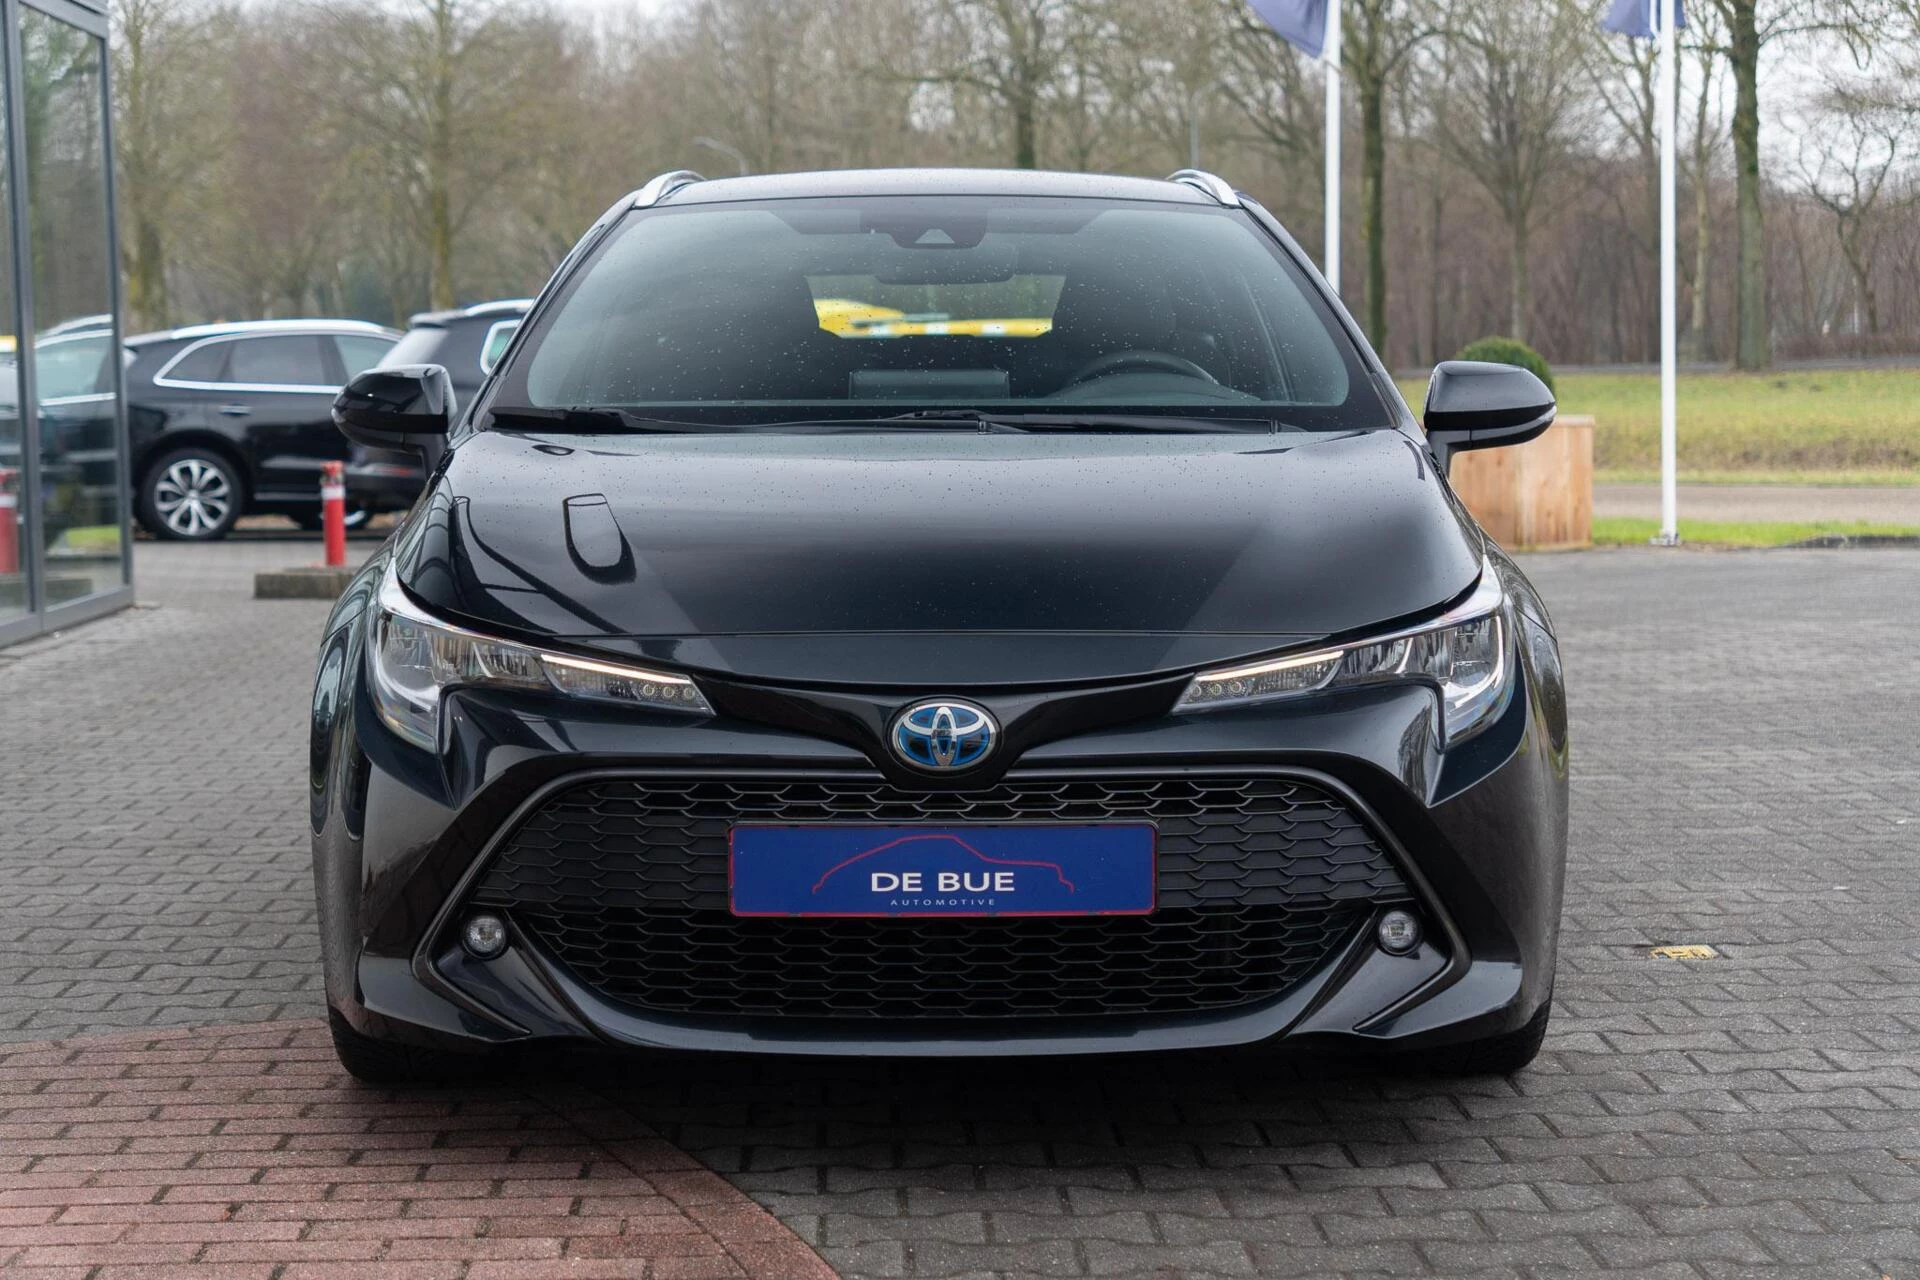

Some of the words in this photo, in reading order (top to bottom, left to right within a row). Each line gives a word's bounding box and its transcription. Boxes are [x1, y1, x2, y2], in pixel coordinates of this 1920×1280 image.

[871, 872, 923, 892] DE
[938, 872, 1015, 892] BUE
[890, 898, 995, 906] AUTOMOTIVE
